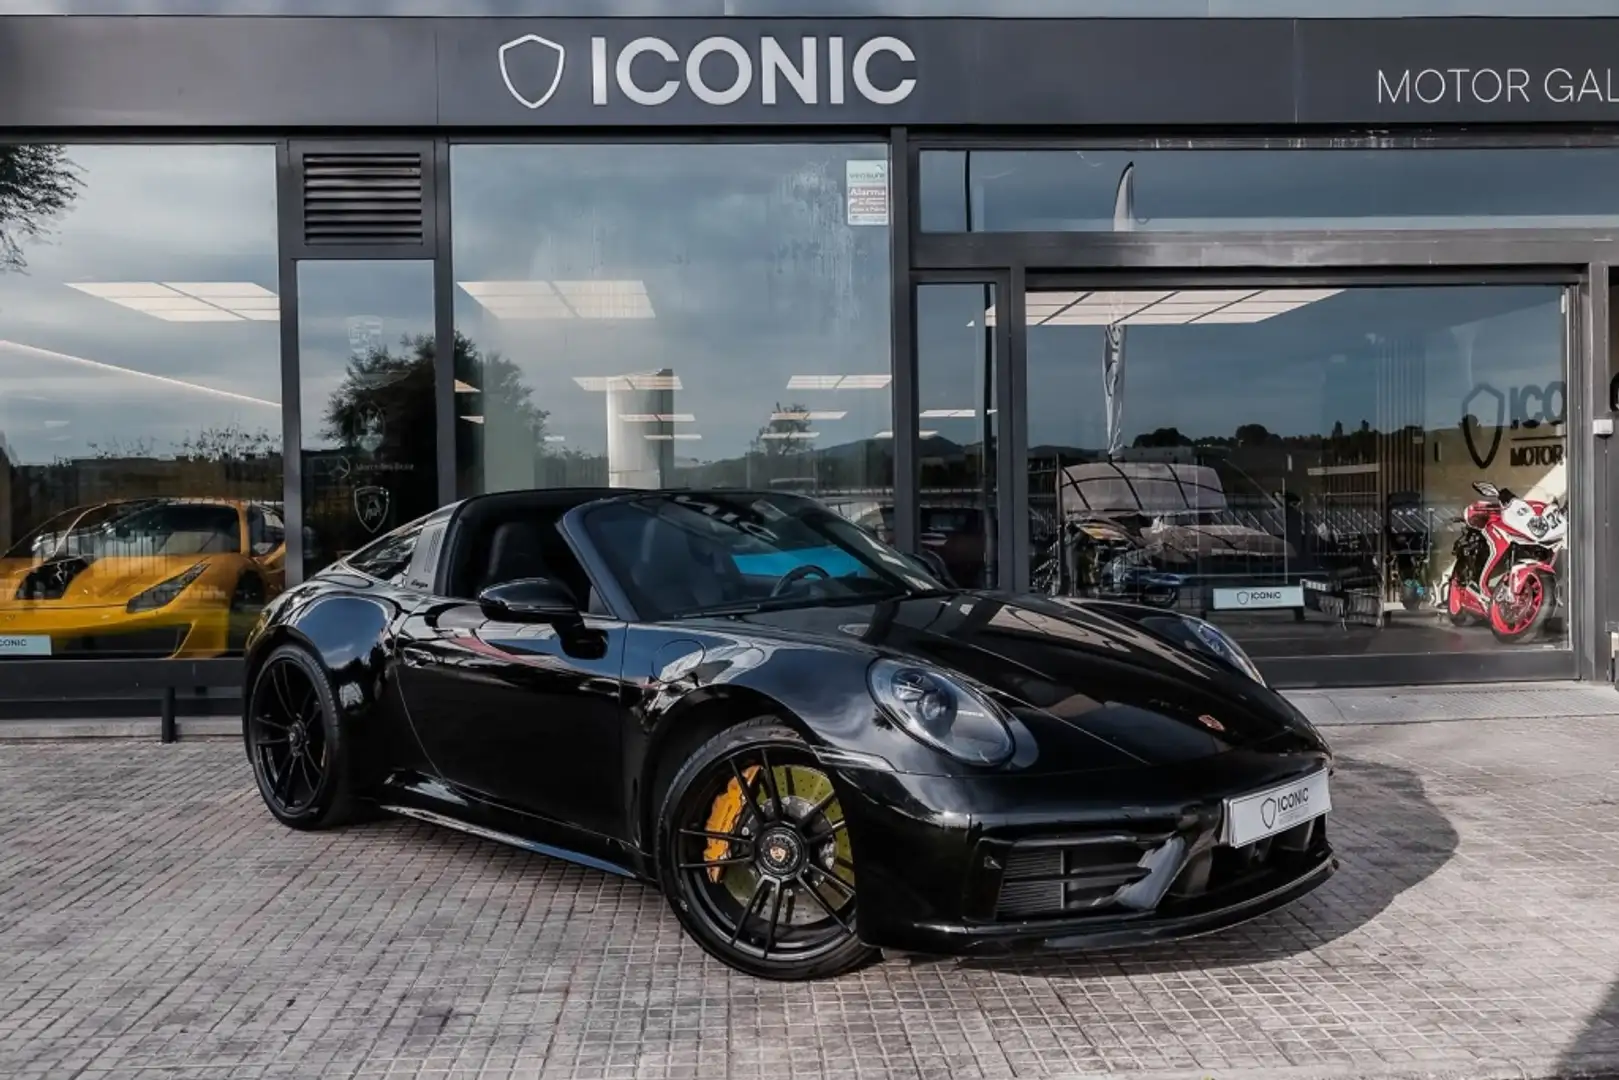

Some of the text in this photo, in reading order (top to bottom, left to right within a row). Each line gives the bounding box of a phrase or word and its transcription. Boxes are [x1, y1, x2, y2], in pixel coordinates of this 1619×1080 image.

[591, 36, 917, 106] ICONIC
[1378, 68, 1530, 103] MOTOR
[1510, 444, 1564, 466] MOTOR
[1250, 591, 1281, 600] ICONIC
[1277, 787, 1309, 813] ICONIC
